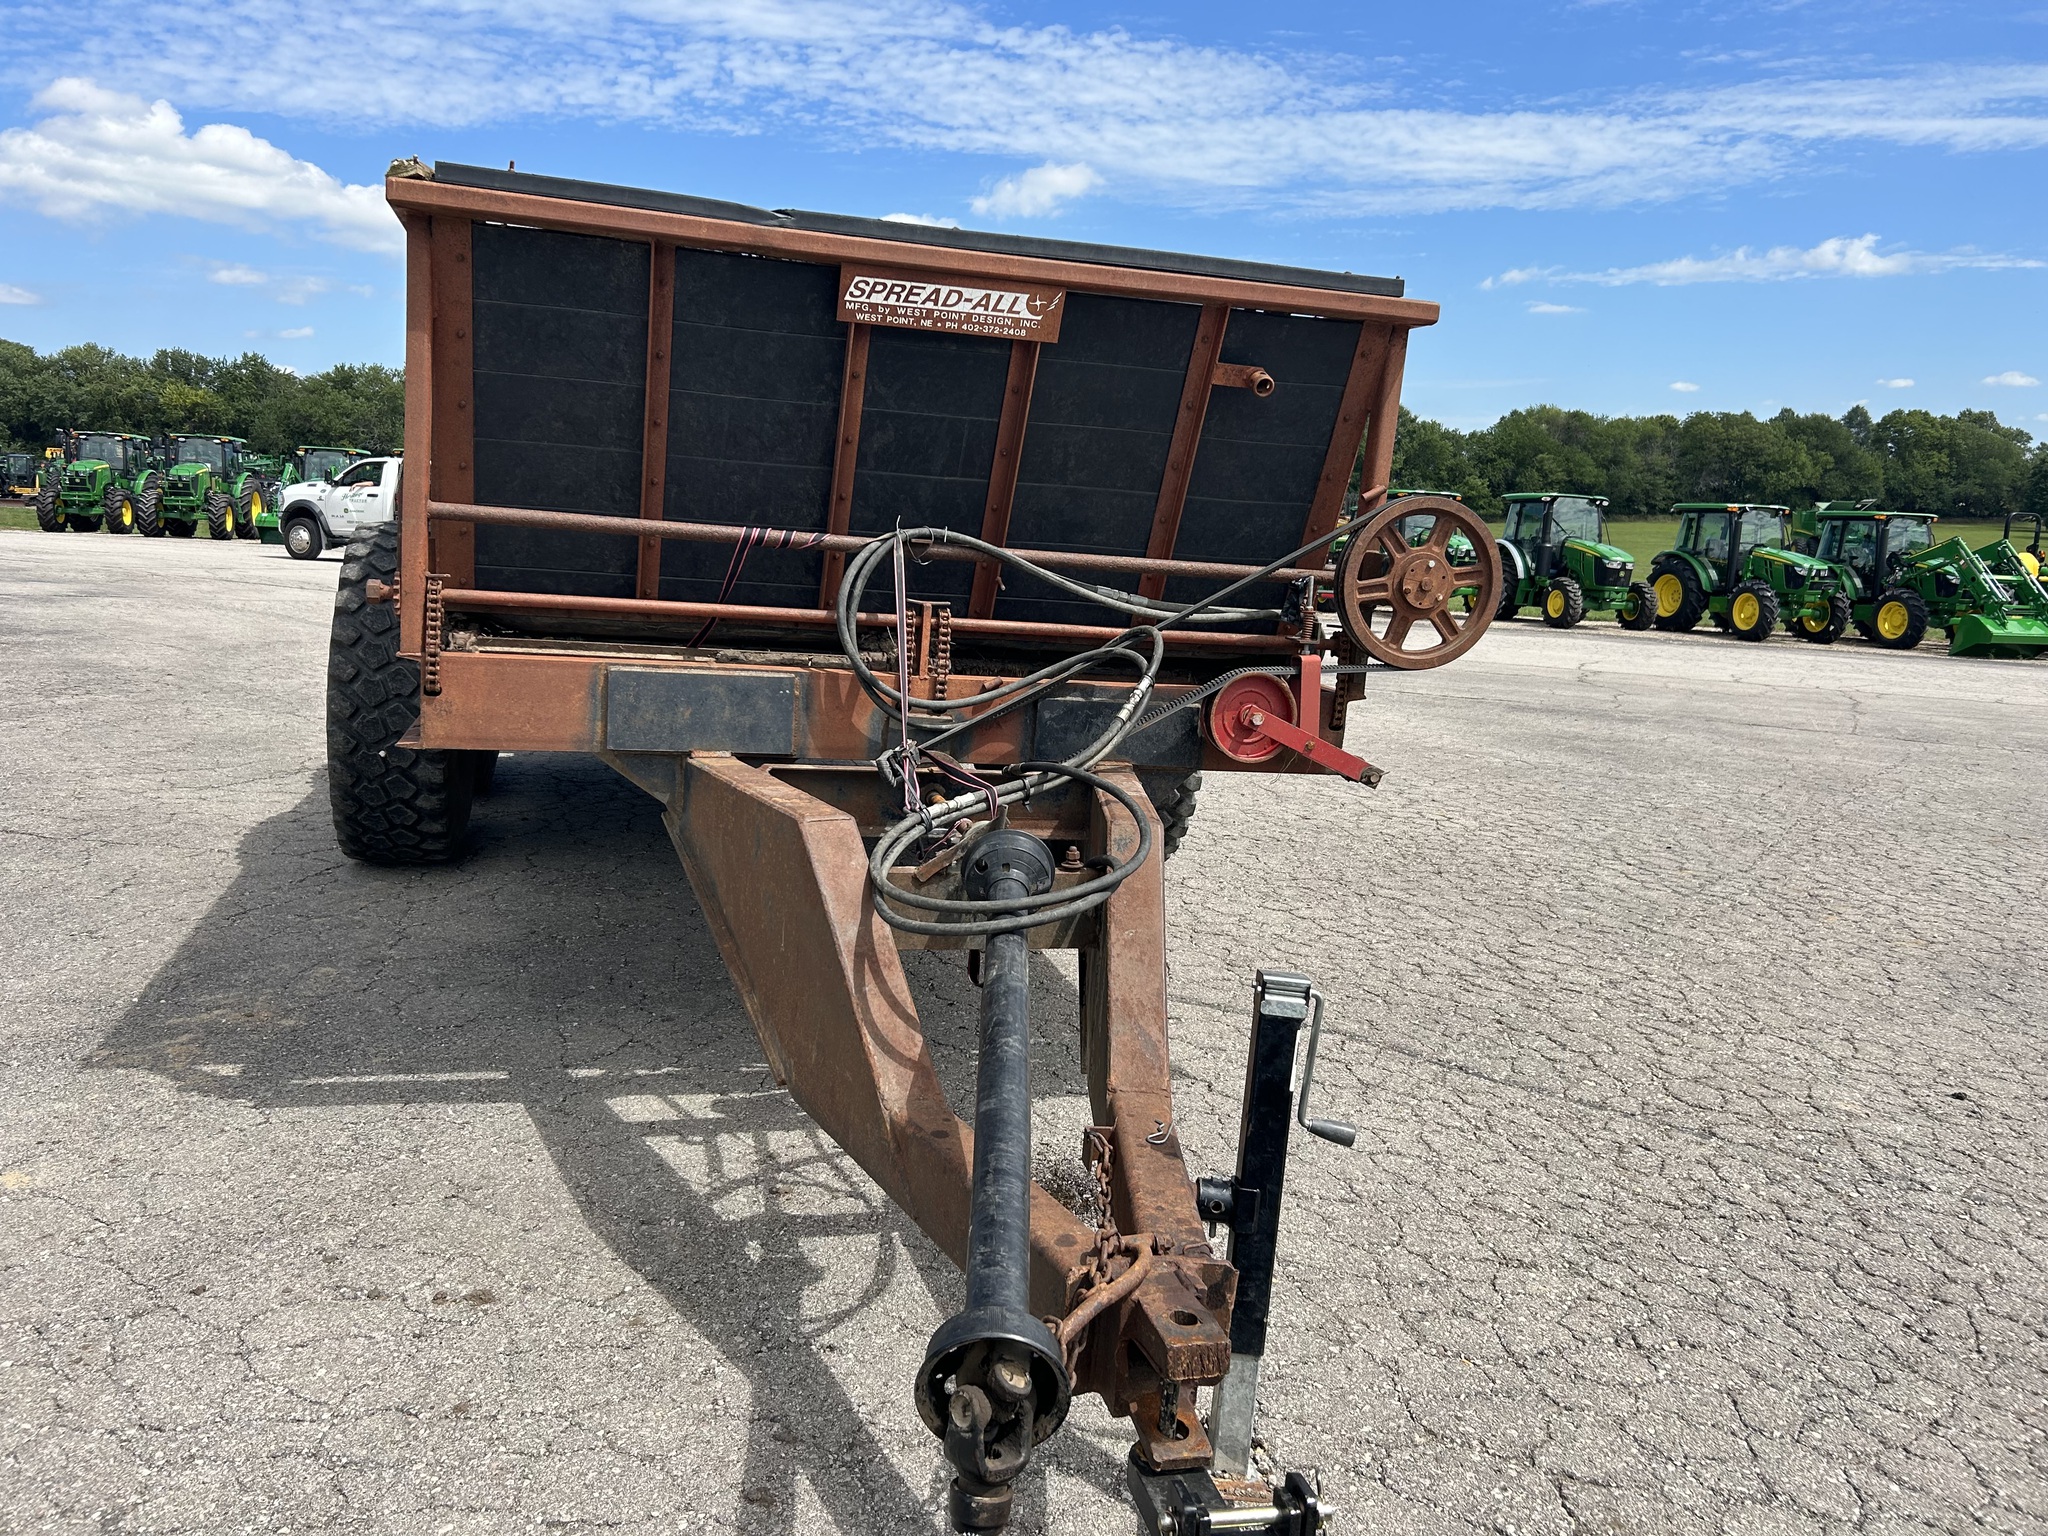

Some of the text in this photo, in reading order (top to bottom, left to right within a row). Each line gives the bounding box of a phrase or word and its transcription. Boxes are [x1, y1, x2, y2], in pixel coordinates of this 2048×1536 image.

[848, 279, 1022, 315] SPREAD-ALL
[845, 301, 1041, 329] MFG. by WEST POINT DESIGN, INC.
[856, 312, 883, 322] WEST
[886, 316, 917, 326] POINT,
[920, 319, 934, 327] NE
[945, 321, 958, 330] PH
